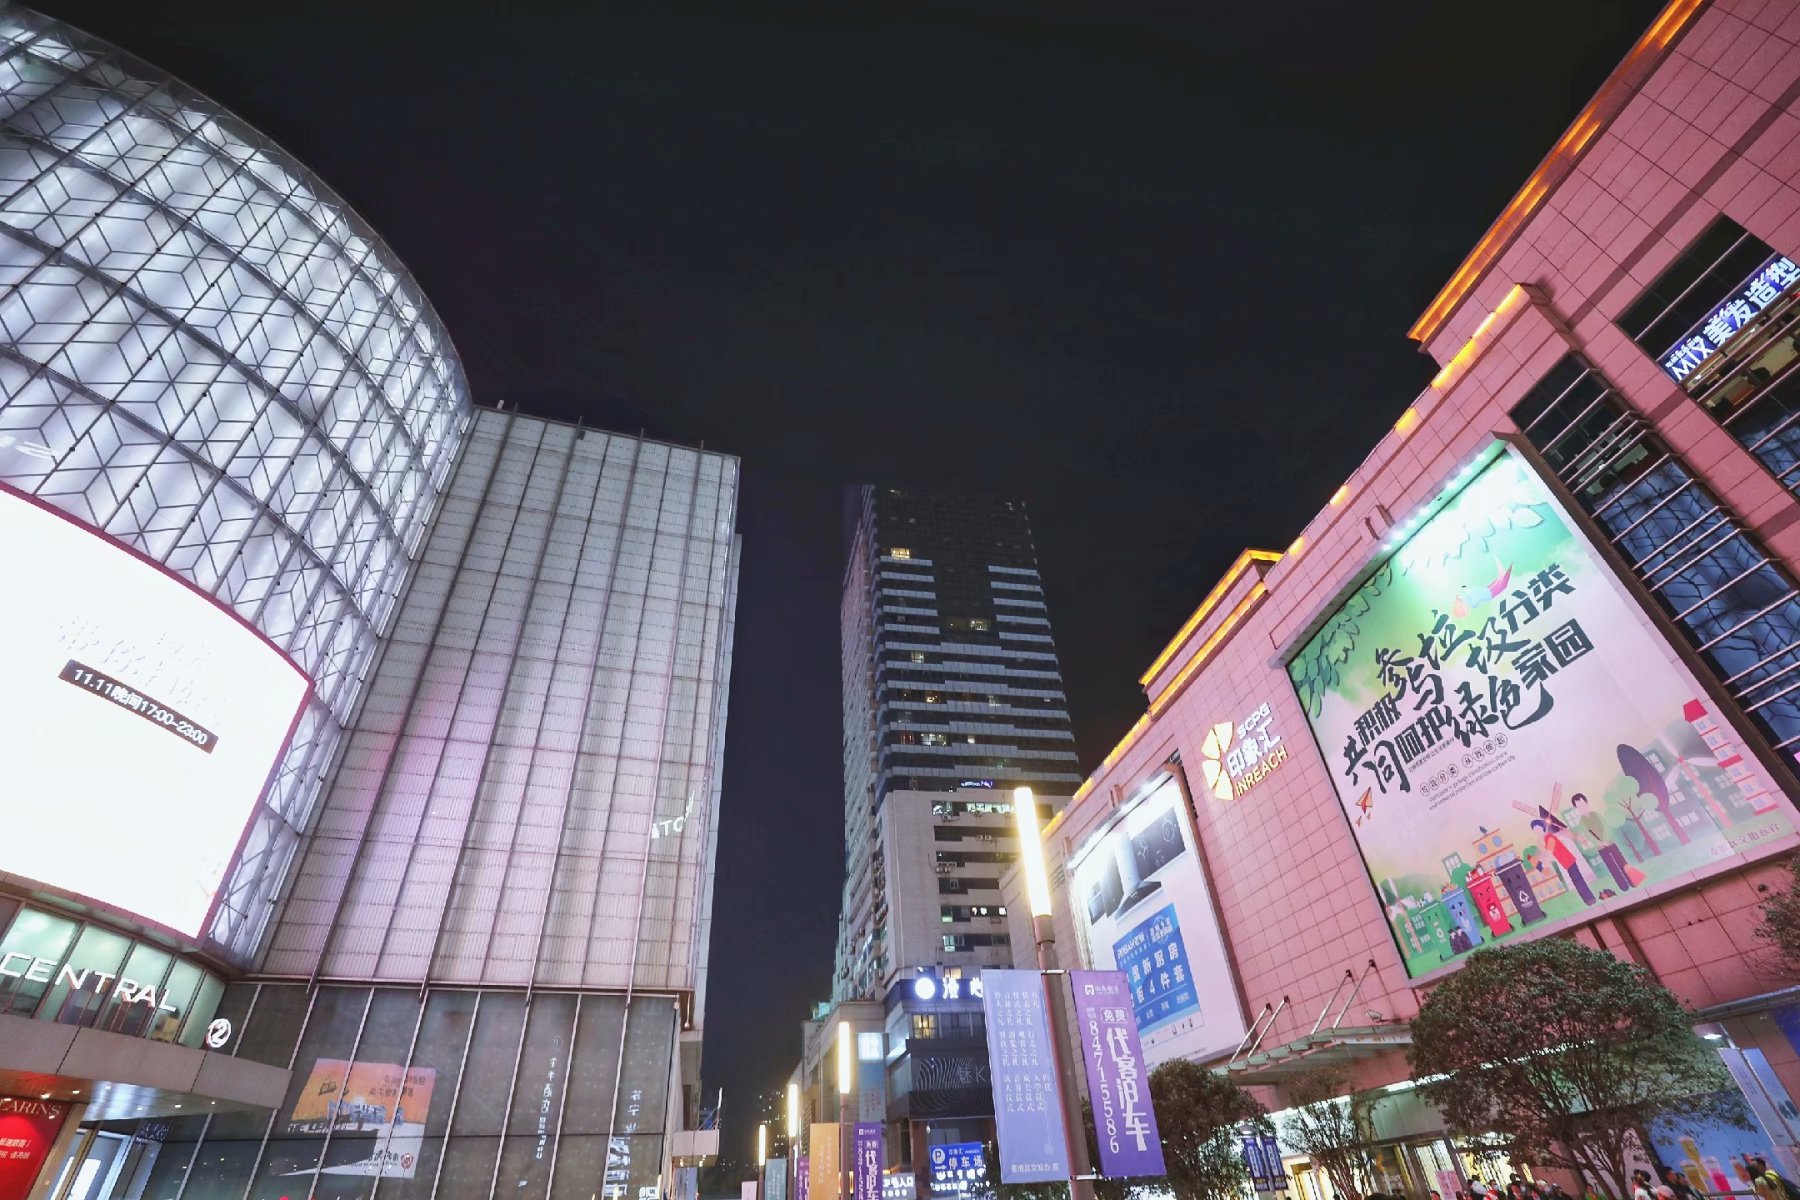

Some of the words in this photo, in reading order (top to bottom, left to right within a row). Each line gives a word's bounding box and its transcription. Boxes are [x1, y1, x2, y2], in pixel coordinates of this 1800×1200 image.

[1354, 563, 1576, 747] 积极参与垃圾分类
[1237, 702, 1271, 739] SCPG
[1343, 618, 1594, 794] 共同呵护绿色家园
[1235, 744, 1288, 797] INREACH
[0, 951, 177, 1012] CENTRAL
[1104, 1009, 1126, 1022] 免费
[1088, 1020, 1120, 1154] 84715586
[1106, 1027, 1151, 1151] 代客泊车
[934, 1150, 943, 1162] P
[948, 1155, 983, 1170] 停车场
